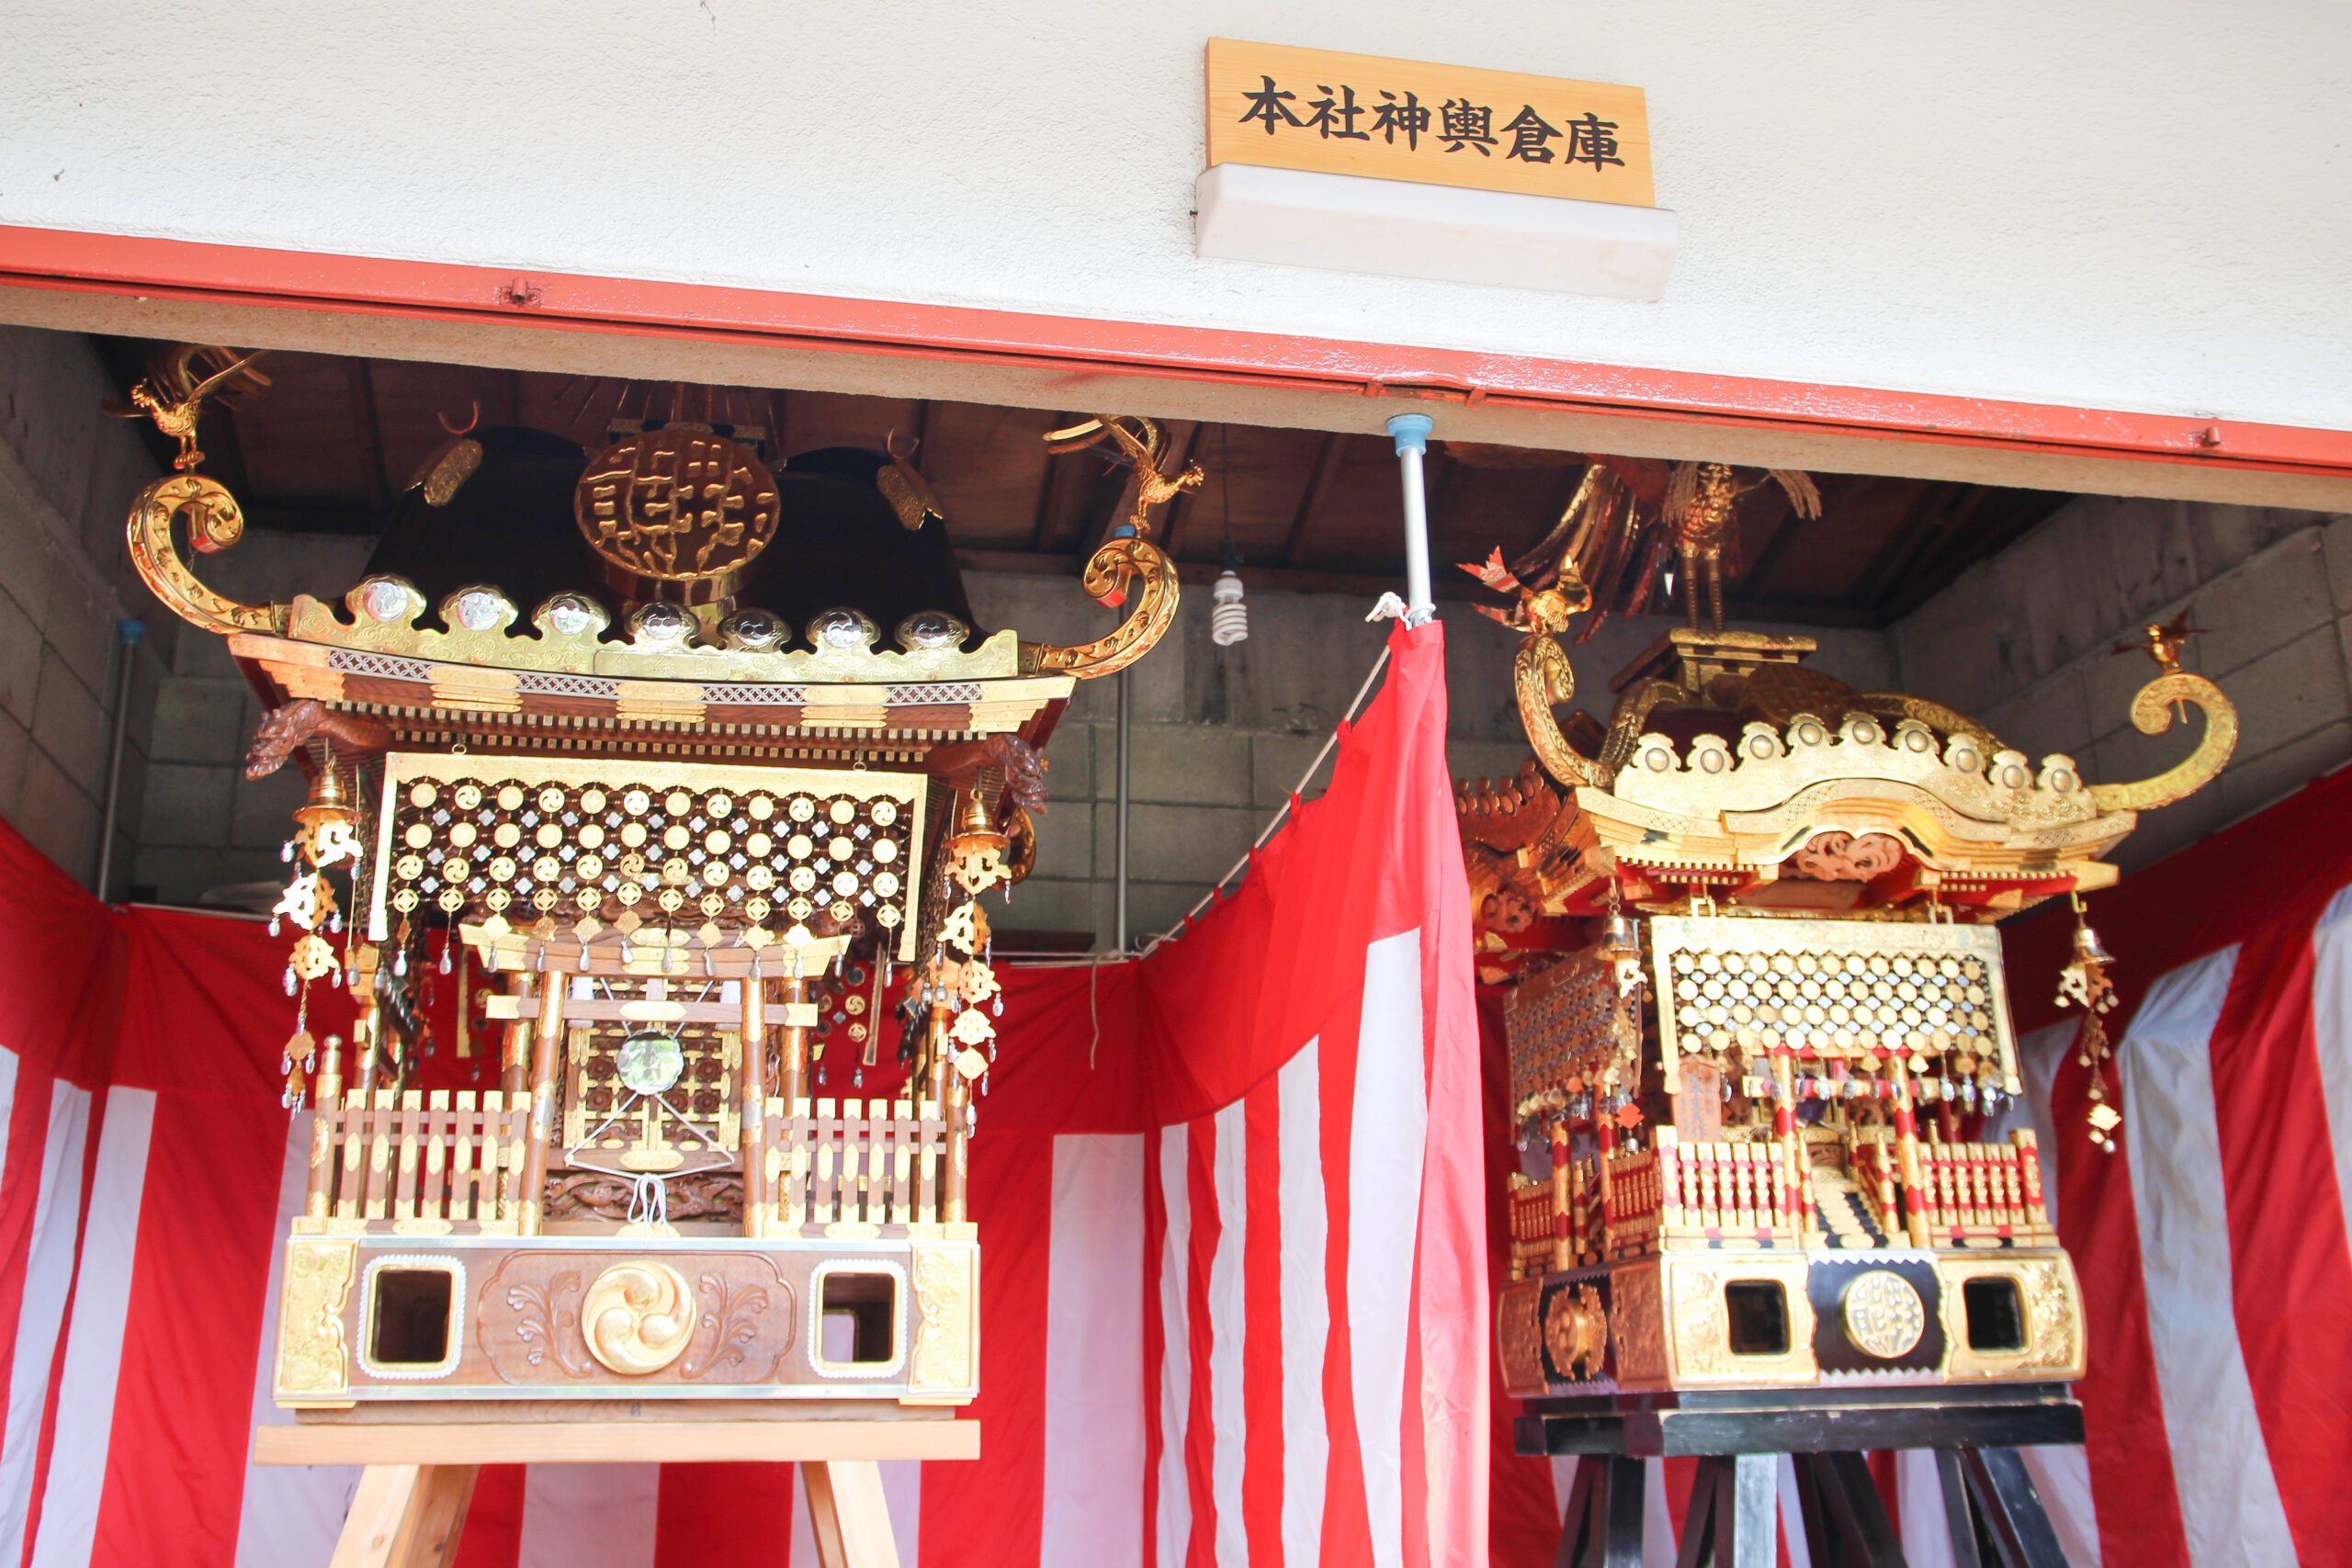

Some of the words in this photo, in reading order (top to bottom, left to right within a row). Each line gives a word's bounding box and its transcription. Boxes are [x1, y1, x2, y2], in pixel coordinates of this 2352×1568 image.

[1238, 75, 1625, 173] 本社神輿倉庫
